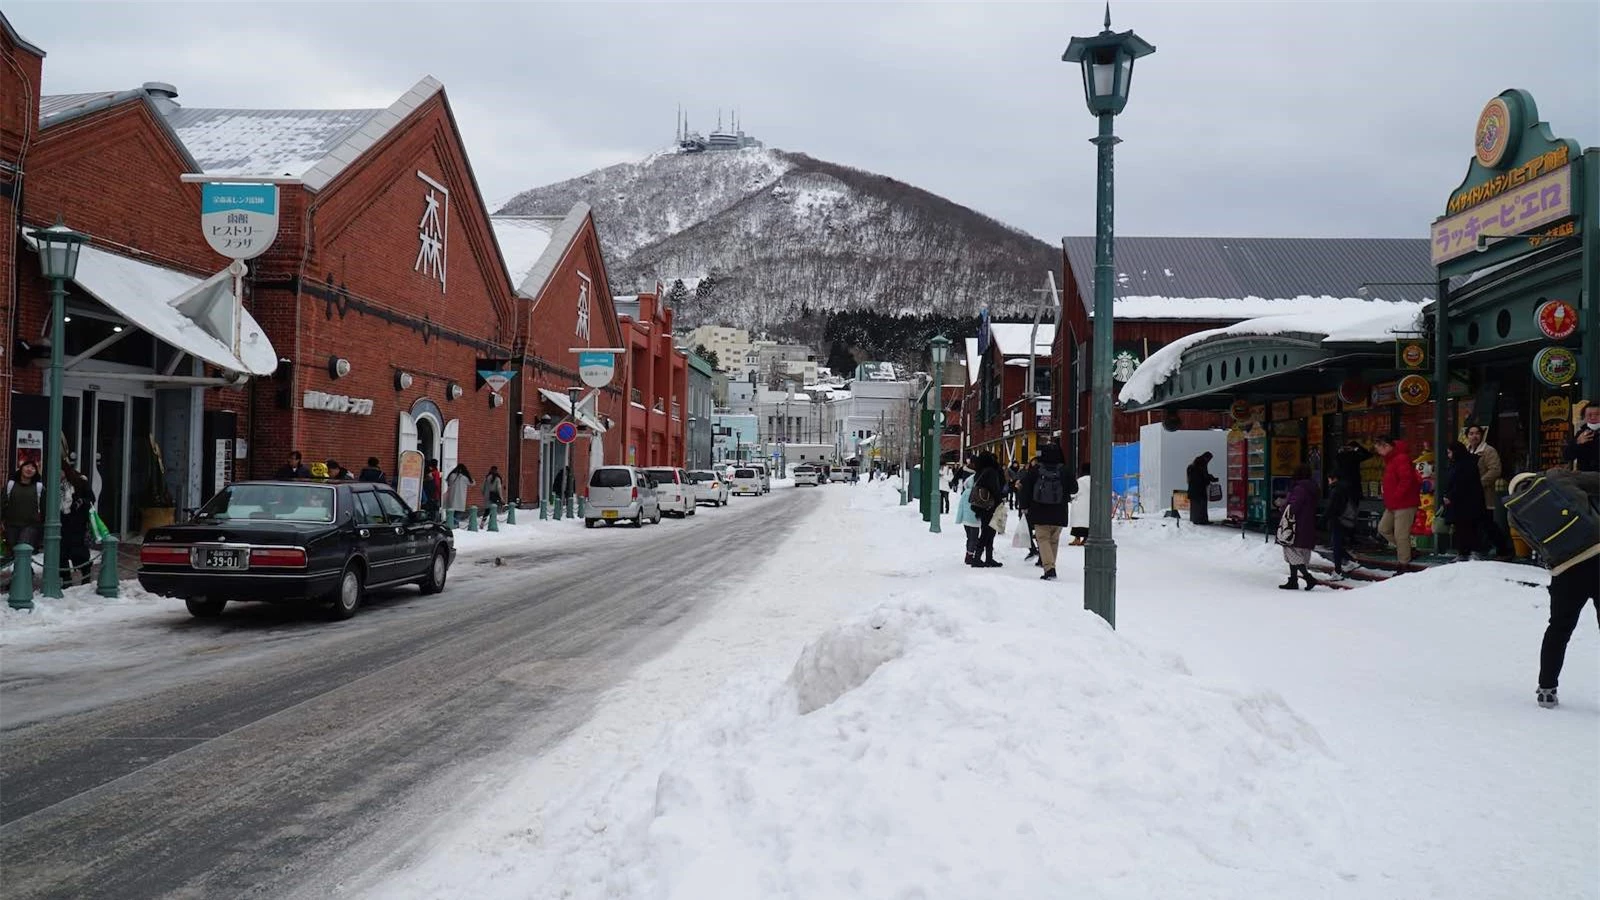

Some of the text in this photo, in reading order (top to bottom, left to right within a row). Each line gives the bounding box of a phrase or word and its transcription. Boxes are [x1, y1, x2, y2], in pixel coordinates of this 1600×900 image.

[1436, 183, 1561, 252] ラッキーピエロ
[212, 225, 264, 236] ヒストリー
[212, 556, 238, 567] 39-01
